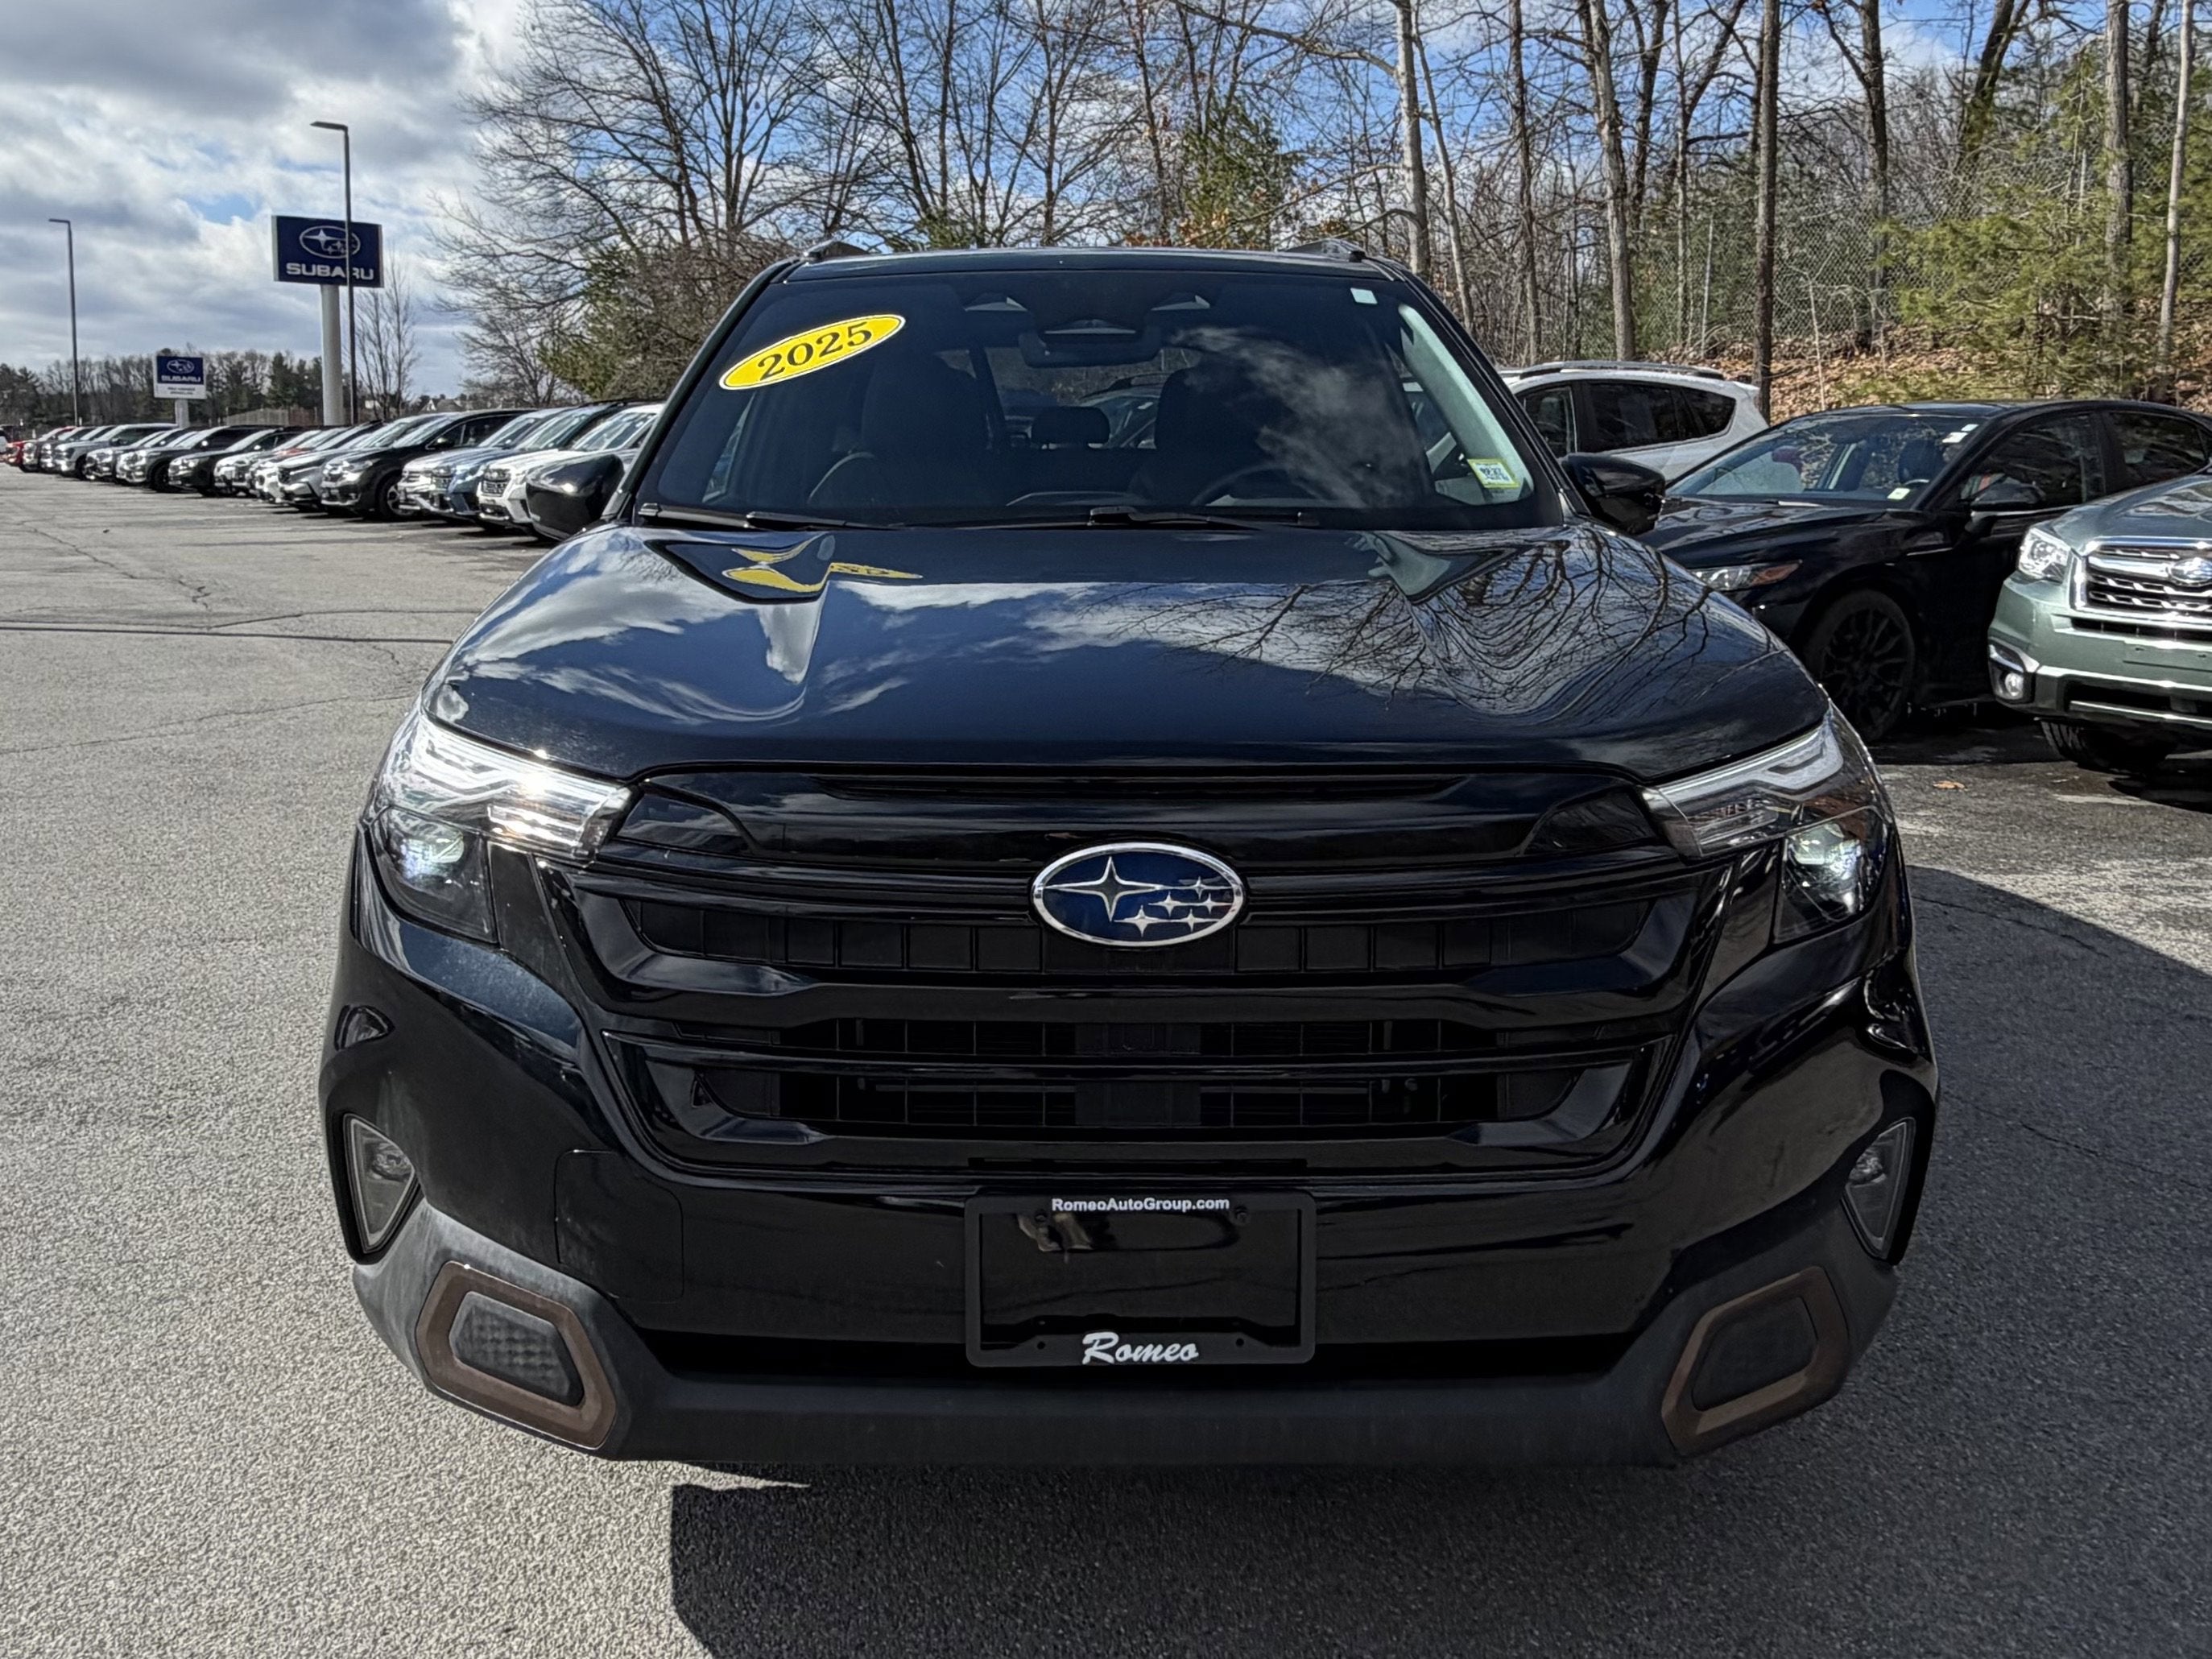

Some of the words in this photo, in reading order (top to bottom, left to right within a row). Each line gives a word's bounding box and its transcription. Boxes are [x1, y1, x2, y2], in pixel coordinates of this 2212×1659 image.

[757, 321, 872, 381] 2025
[1052, 1198, 1230, 1213] RomeoAutoGroup.com
[1081, 1331, 1199, 1365] Romeo
